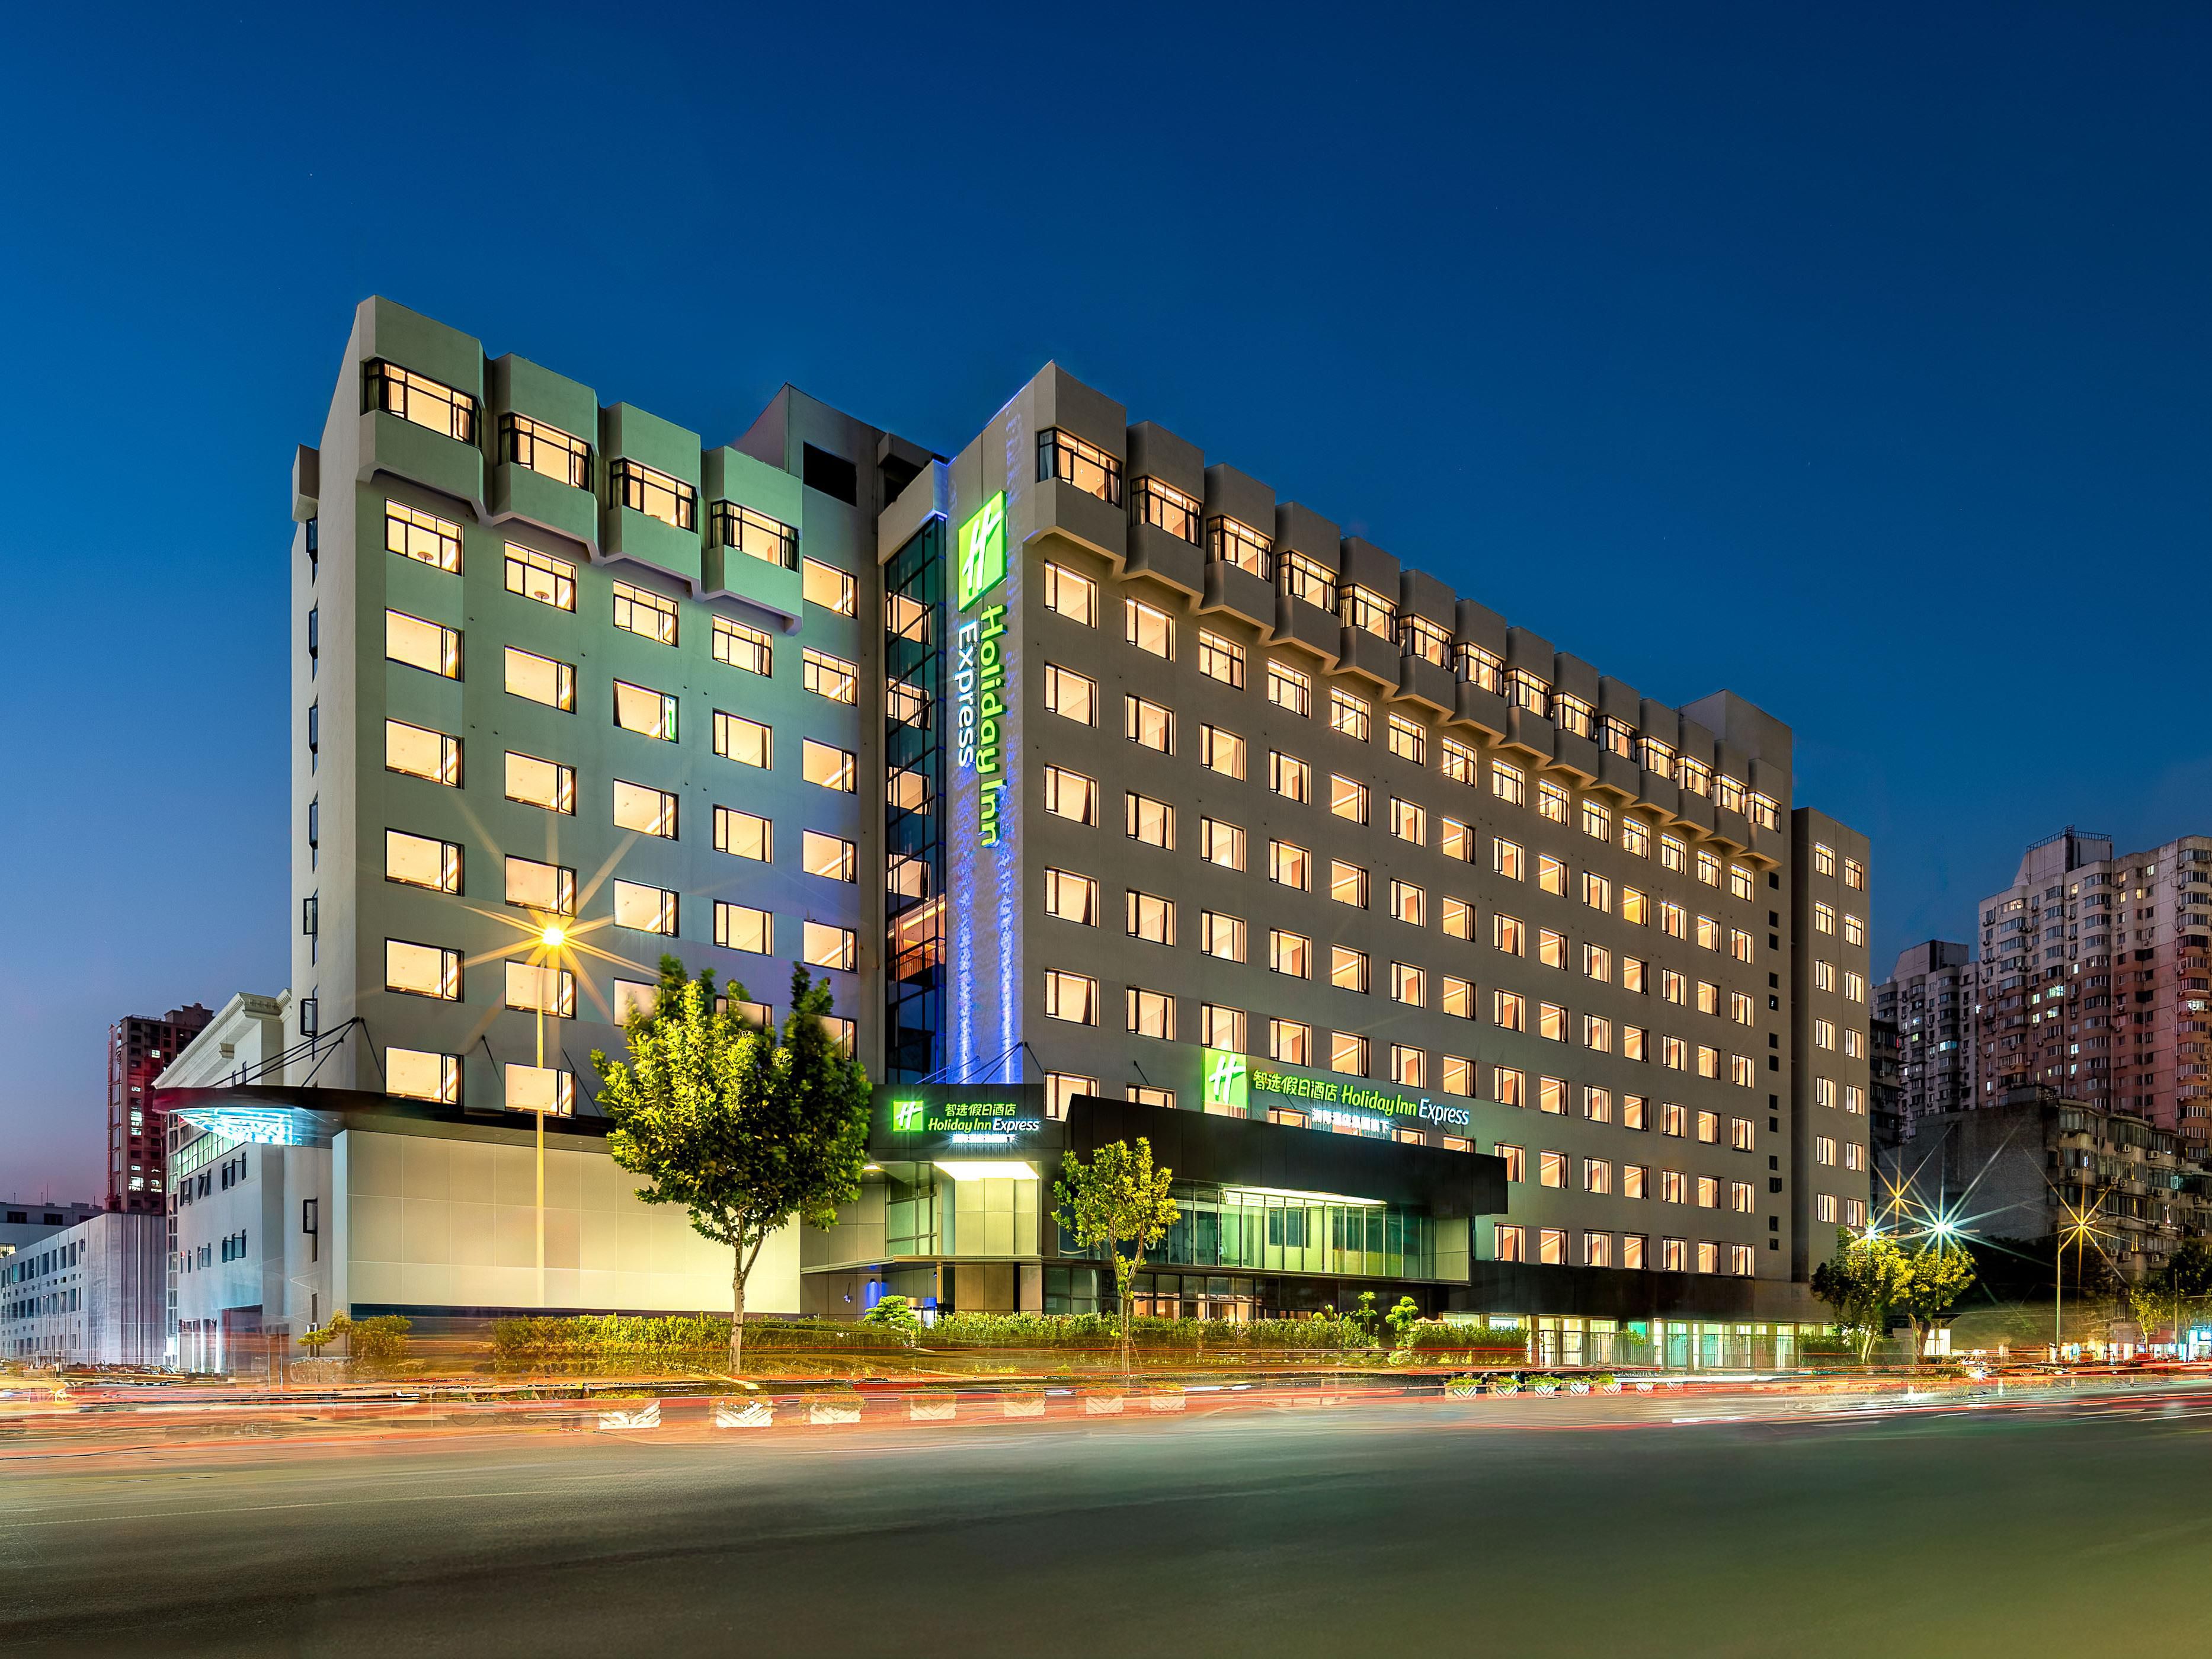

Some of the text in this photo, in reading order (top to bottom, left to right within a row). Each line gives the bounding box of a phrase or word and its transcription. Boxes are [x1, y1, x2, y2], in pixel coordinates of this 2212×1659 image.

[954, 620, 978, 768] Express
[976, 604, 1006, 847] Holiday Inn
[928, 1117, 1041, 1133] Holiday Inn Express
[945, 1103, 1016, 1117] 智选假日酒店
[1253, 1069, 1338, 1102] 智选假日酒店
[1341, 1084, 1394, 1116] Holiday
[1395, 1094, 1417, 1116] Inn
[1419, 1097, 1470, 1126] Express
